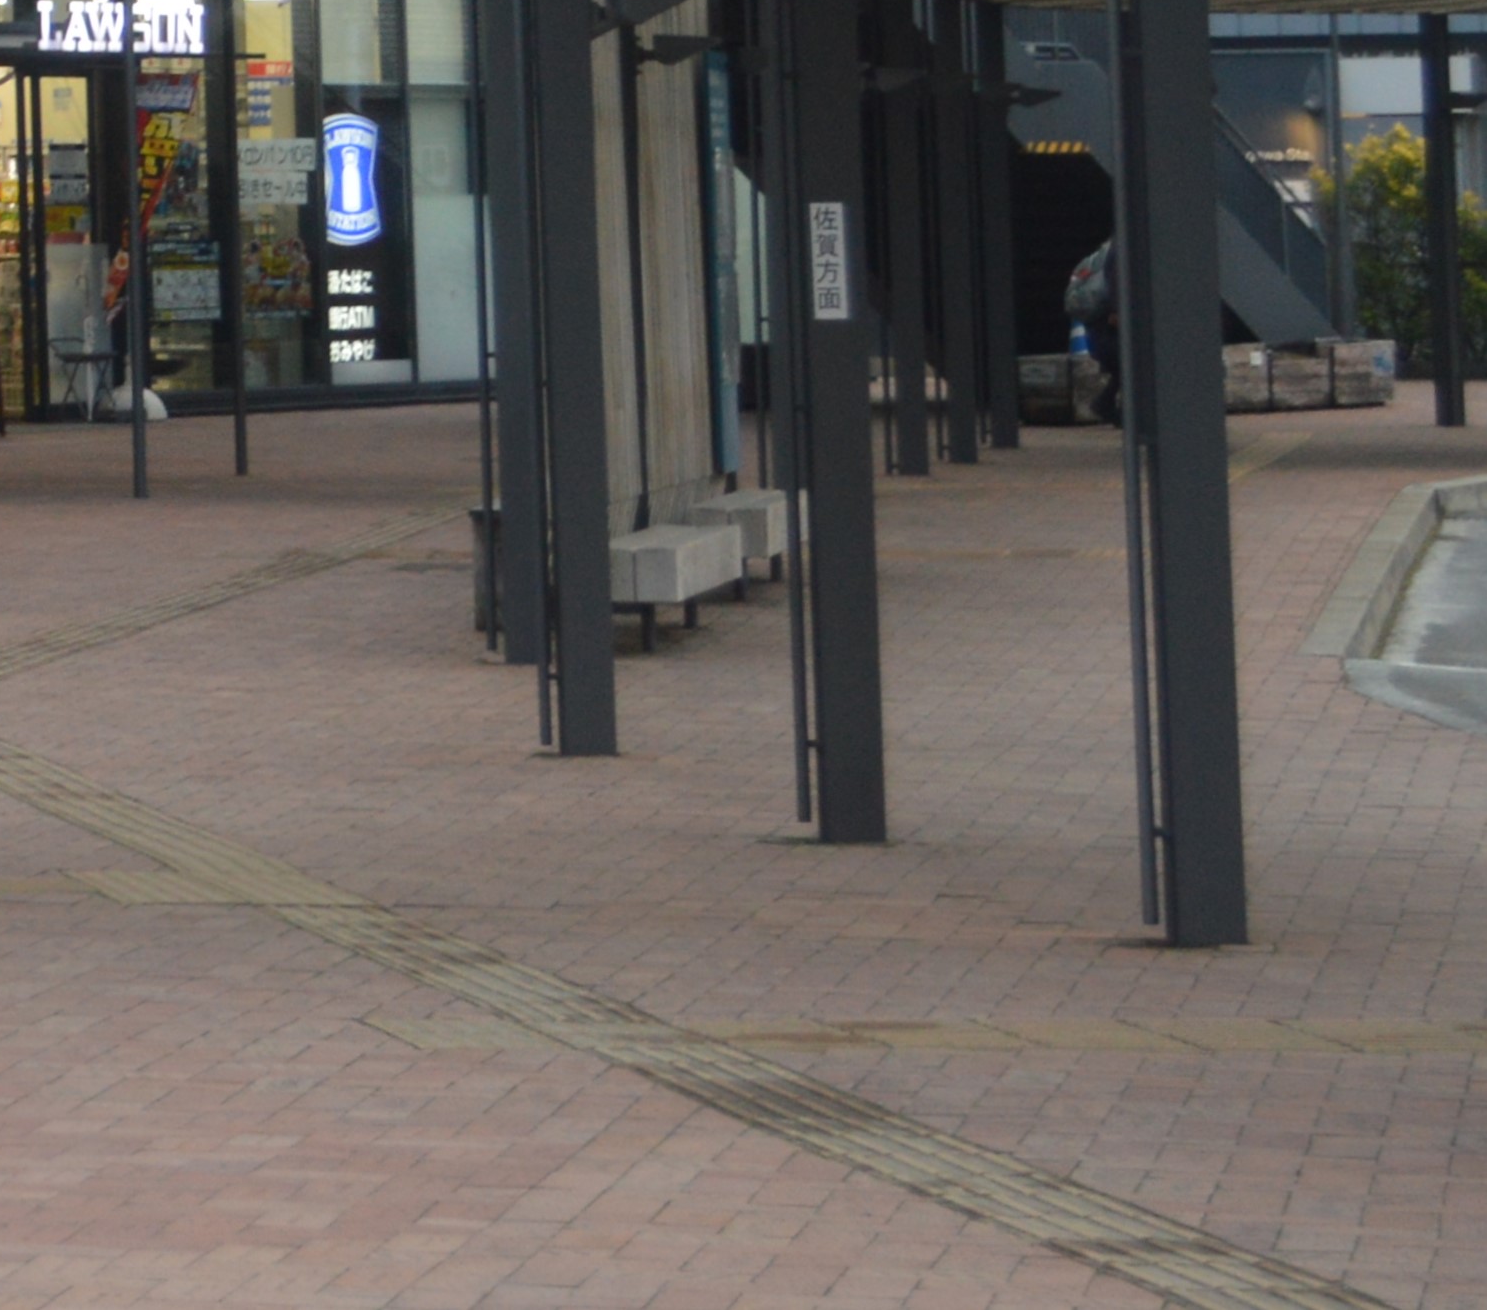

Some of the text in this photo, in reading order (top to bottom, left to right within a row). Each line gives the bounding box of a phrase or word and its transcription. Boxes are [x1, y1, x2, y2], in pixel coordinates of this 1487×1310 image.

[813, 206, 841, 310] 佐賀方面
[328, 304, 376, 331] 銀行ATM
